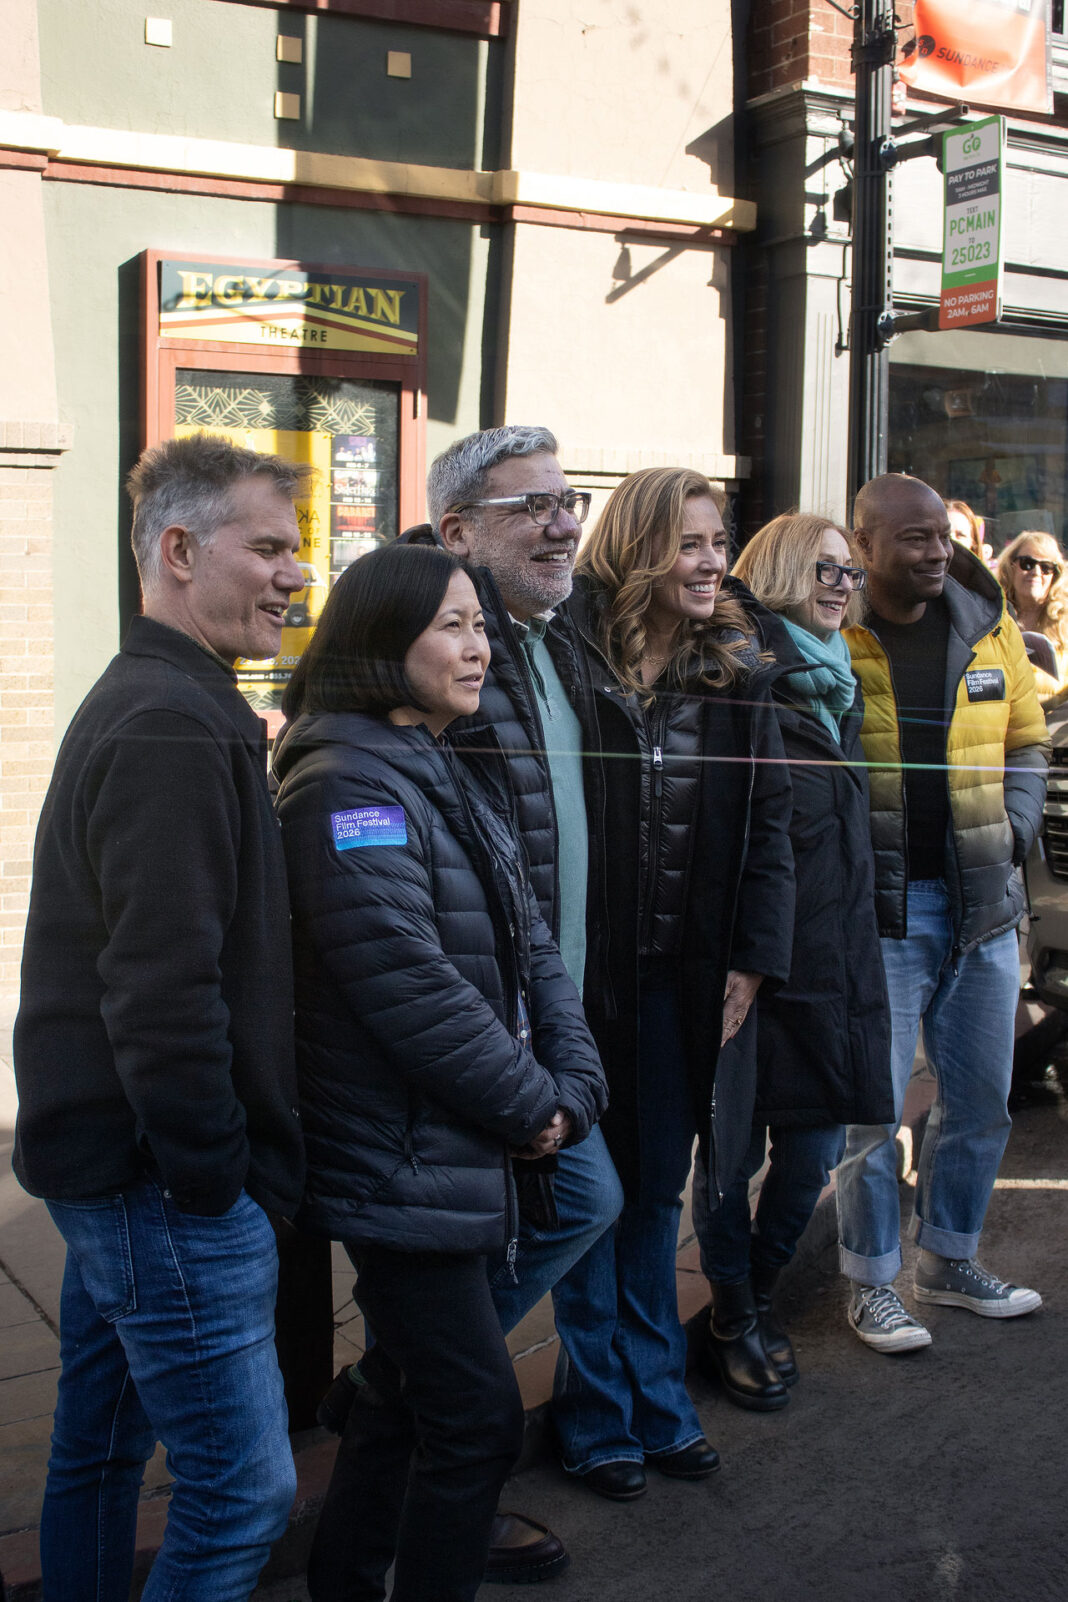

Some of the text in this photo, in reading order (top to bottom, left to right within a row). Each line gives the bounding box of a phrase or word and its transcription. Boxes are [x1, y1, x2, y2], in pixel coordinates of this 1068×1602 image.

[936, 47, 999, 73] SUNDANCE
[948, 164, 997, 185] PAY TO PARK
[967, 206, 978, 214] TEXT
[950, 209, 995, 237] PCMAIN
[951, 241, 991, 266] 25023
[176, 270, 406, 326] EGYPTIAN
[944, 289, 995, 308] NO PARKING
[947, 308, 965, 319] 2AM
[971, 303, 989, 315] 6AM
[260, 326, 328, 342] THEATRE
[966, 672, 992, 680] Sundance
[980, 677, 999, 685] Festival
[334, 811, 380, 823] Sundance
[336, 817, 391, 831] Film Festival
[337, 828, 360, 840] 2026
